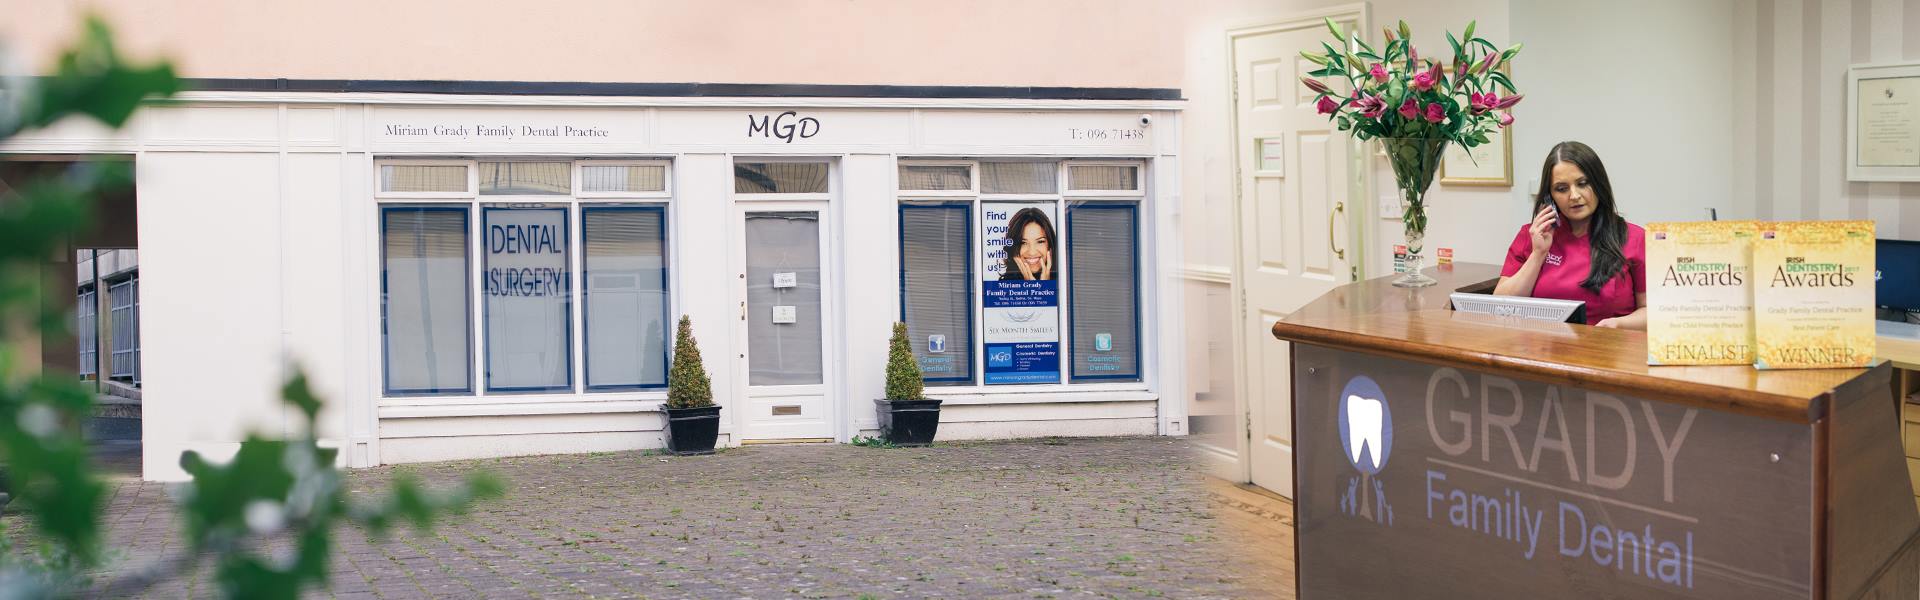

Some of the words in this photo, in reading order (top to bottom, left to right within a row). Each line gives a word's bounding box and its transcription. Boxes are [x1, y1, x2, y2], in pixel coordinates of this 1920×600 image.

[385, 124, 428, 136] Miriam
[433, 124, 470, 140] Grady
[476, 124, 516, 140] Family
[522, 125, 559, 137] Dental
[565, 125, 609, 138] Practice
[748, 111, 820, 143] MGD
[1068, 128, 1083, 139] T:
[1087, 128, 1107, 139] 096
[1112, 128, 1144, 139] 71438
[986, 211, 1007, 220] Find
[986, 226, 1009, 235] your
[491, 224, 562, 254] DENTAL
[986, 237, 1014, 246] smile
[987, 250, 1008, 259] with
[1662, 263, 1743, 287] Awards
[1676, 263, 1727, 272] DENTISTRY
[1785, 263, 1838, 273] DENTISTRY
[490, 267, 563, 297] SURGERY
[1770, 264, 1854, 288] Awards
[990, 351, 1012, 363] MGD
[1665, 344, 1749, 360] FINALIST
[1778, 347, 1856, 364] WINNER
[1424, 367, 1699, 503] GRADY
[1426, 470, 1543, 560] Family
[1559, 501, 1694, 589] Dental
